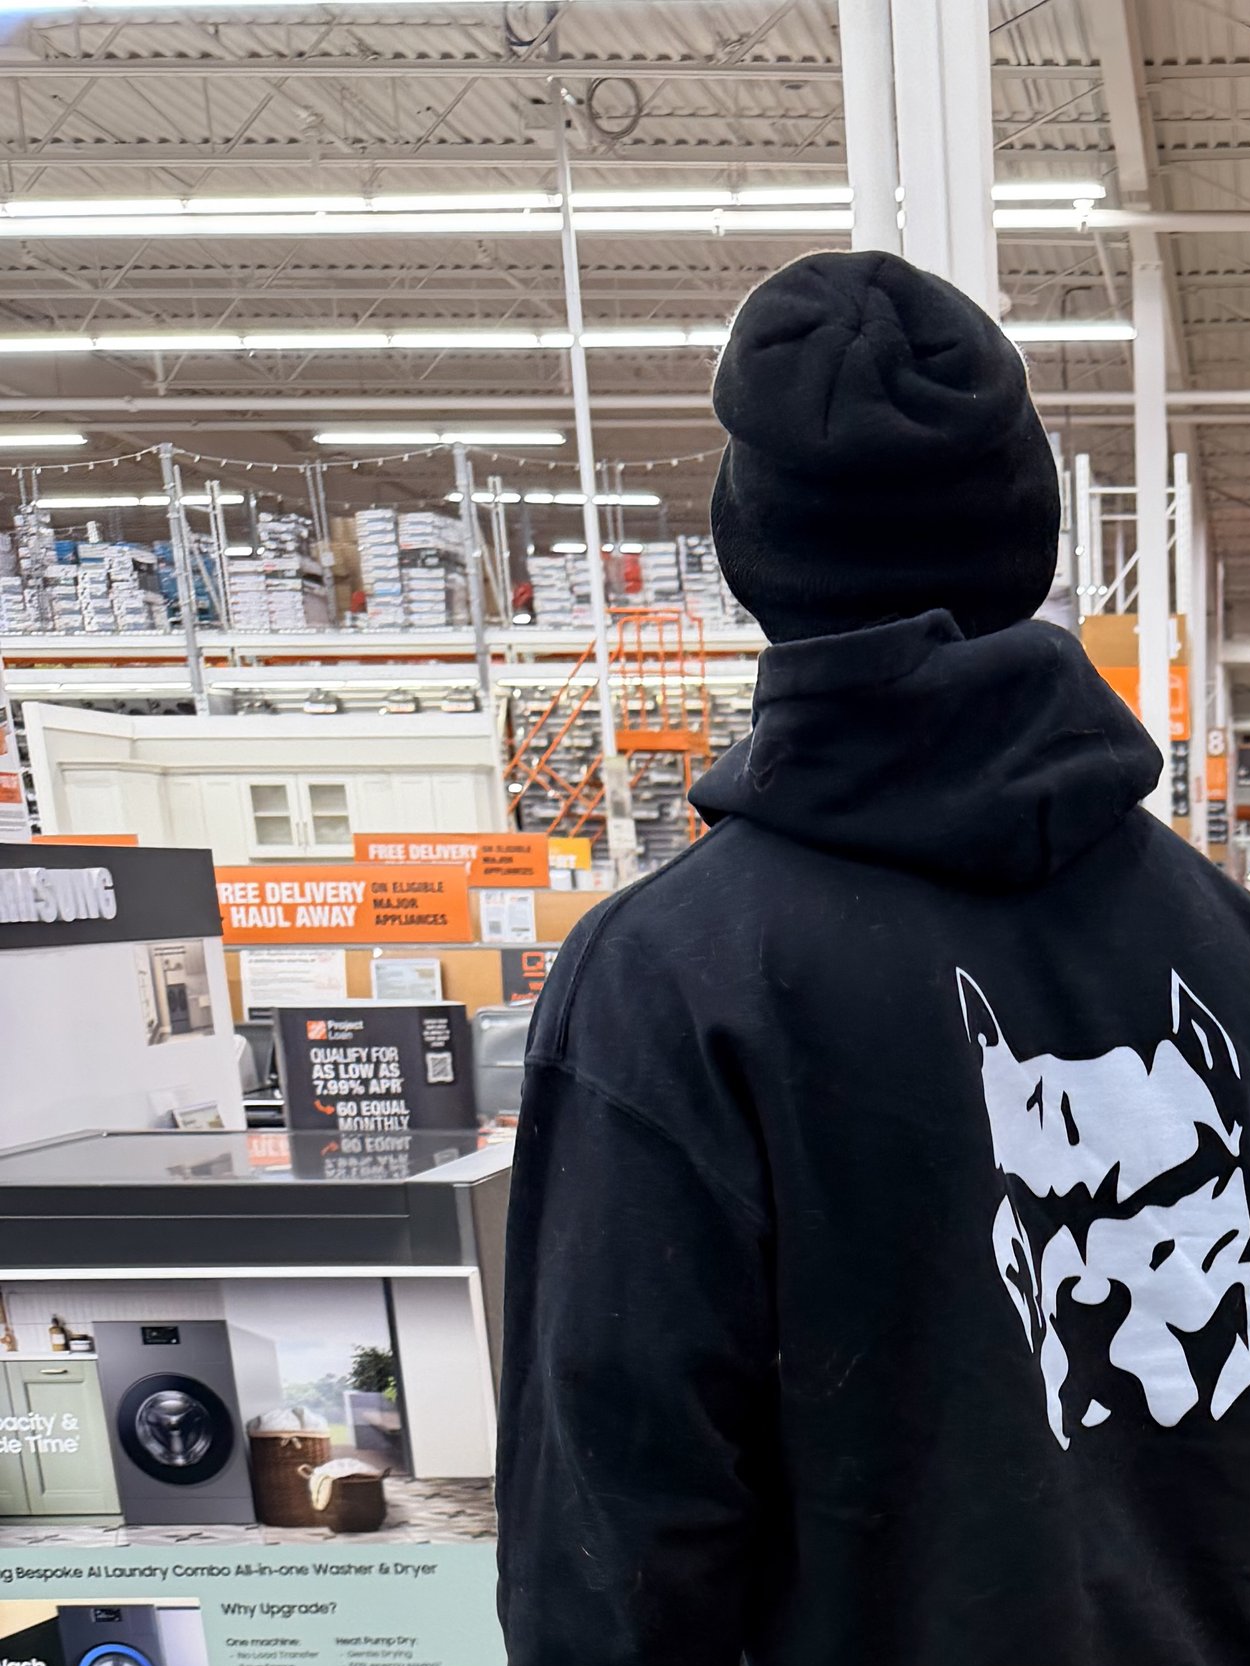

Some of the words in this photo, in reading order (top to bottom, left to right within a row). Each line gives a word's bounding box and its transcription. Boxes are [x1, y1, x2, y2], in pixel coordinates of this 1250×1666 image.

[368, 844, 407, 860] FREE
[408, 844, 478, 860] DELIVERY
[265, 881, 366, 904] DELIVERY
[392, 882, 444, 894] ELIGIBLE
[373, 898, 418, 909] MAJOR
[231, 906, 292, 928] HAUL
[295, 905, 358, 927] AWAY
[375, 914, 448, 926] APPLIANCES
[328, 1020, 364, 1032] Project
[310, 1048, 369, 1063] QUALIFY
[371, 1047, 399, 1062] FOR
[312, 1064, 336, 1079] AS
[339, 1064, 374, 1078] LOW
[379, 1062, 400, 1077] AS
[313, 1080, 365, 1095] 7.99%
[337, 1102, 357, 1116] 60
[360, 1100, 410, 1115] EQUAL
[339, 1117, 410, 1131] MONTHLY
[61, 1412, 79, 1431] &
[15, 1566, 84, 1582] Bespoke
[104, 1564, 169, 1580] Laundry
[172, 1564, 231, 1577] Combo
[234, 1563, 309, 1576] All-in-one
[313, 1562, 374, 1576] Washer
[378, 1562, 390, 1575] &
[393, 1562, 438, 1578] Dryer
[221, 1603, 257, 1618] Why
[259, 1602, 338, 1618] Upgrade?
